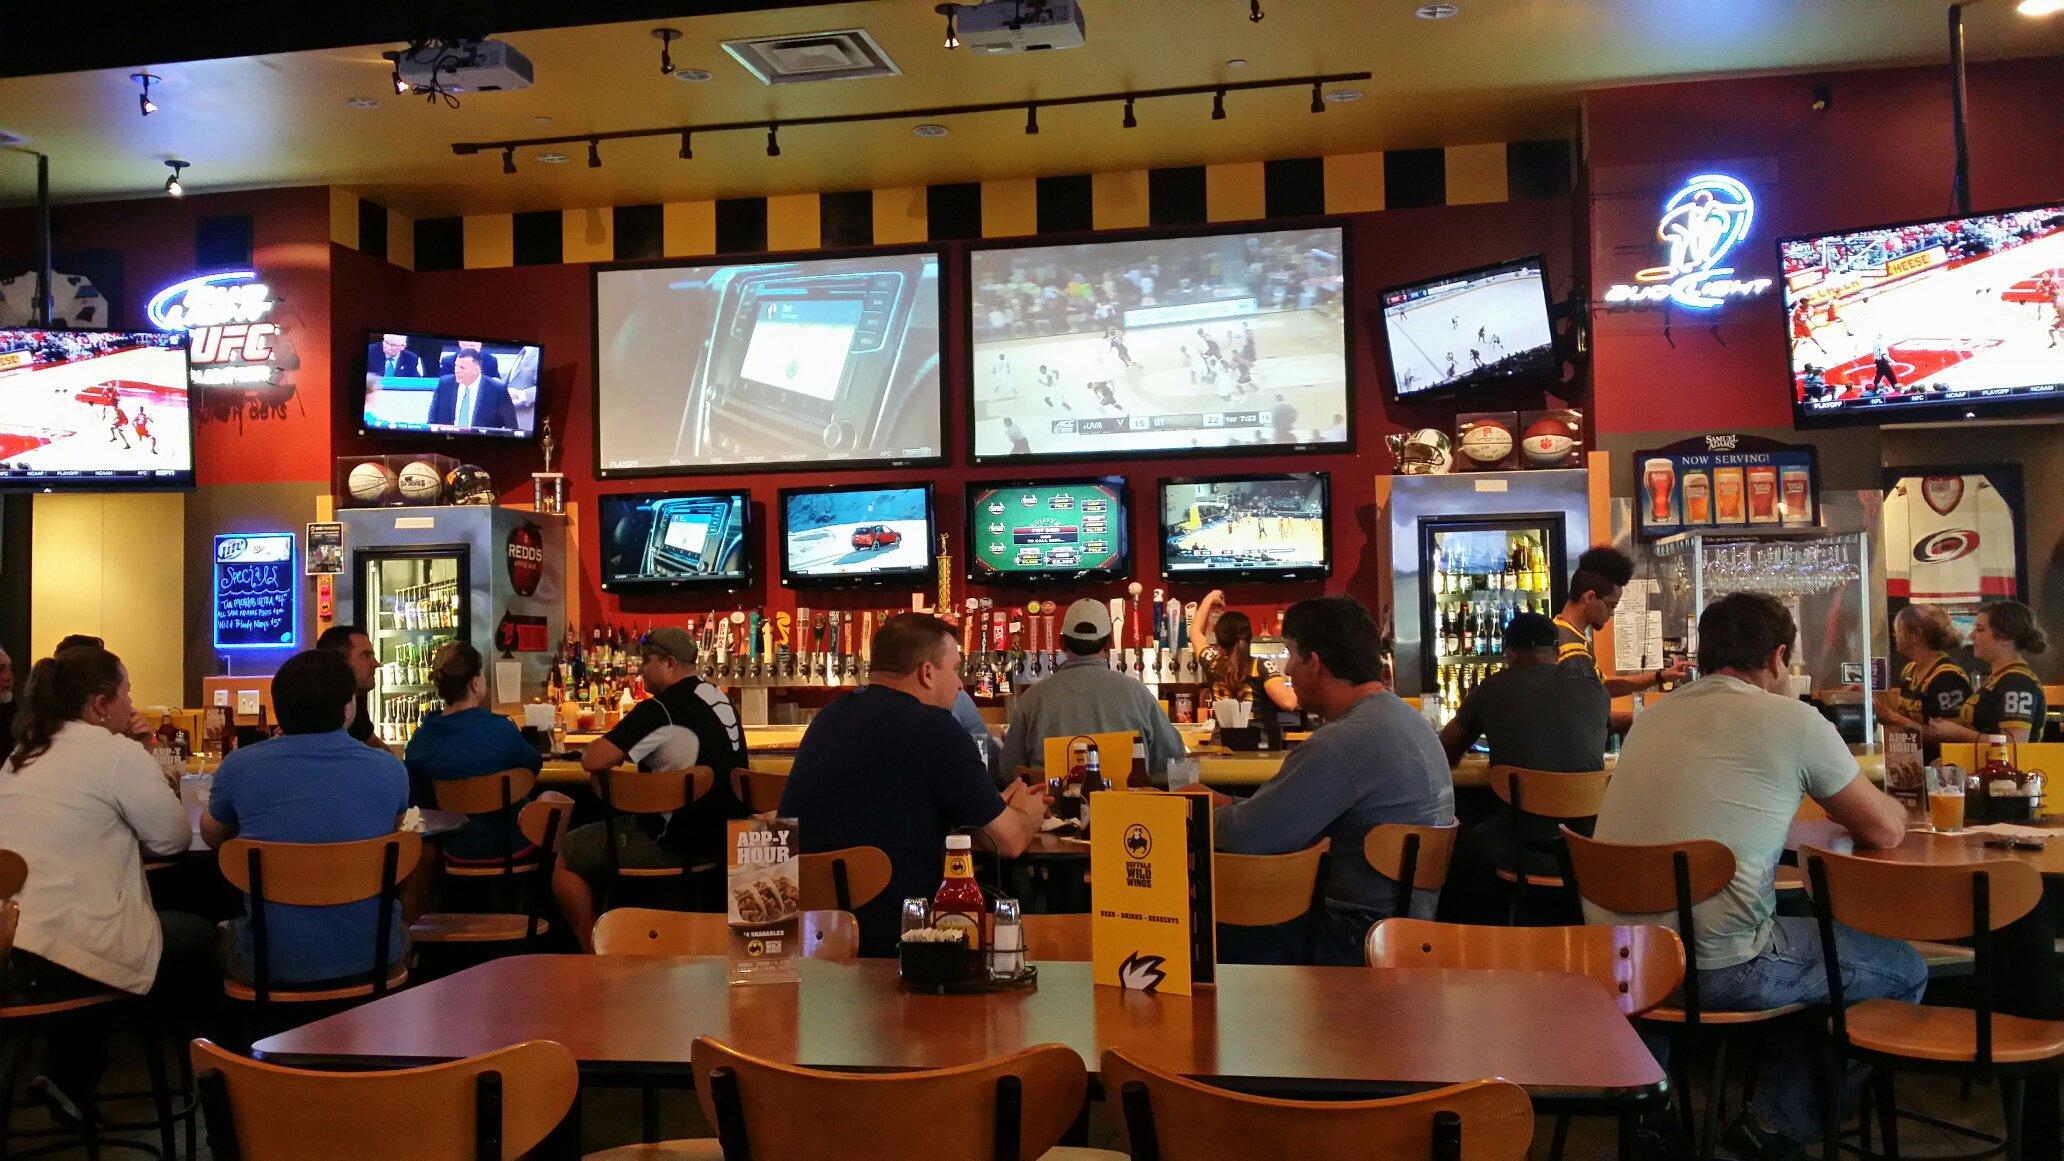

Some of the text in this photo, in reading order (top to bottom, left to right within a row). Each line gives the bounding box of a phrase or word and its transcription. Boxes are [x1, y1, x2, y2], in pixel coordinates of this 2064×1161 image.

[191, 322, 275, 364] UFC
[1982, 387, 2010, 396] PLAYOFF
[1870, 397, 1883, 405] NFL
[1911, 394, 1924, 402] NFC
[1813, 400, 1843, 409] PLAYOFF
[1207, 415, 1219, 424] 22
[1706, 434, 1738, 443] SAMUEL
[1708, 440, 1737, 450] ADAMS
[1682, 453, 1771, 465] NOW SERVING!
[2004, 691, 2033, 715] 82
[737, 830, 790, 847] APP-Y
[737, 846, 790, 864] HOUR
[1125, 861, 1152, 869] BUFFALO
[1126, 867, 1152, 880] WILD
[1126, 878, 1152, 888] WINGS
[1100, 910, 1116, 918] BEER
[1148, 915, 1180, 924] DESSERTS
